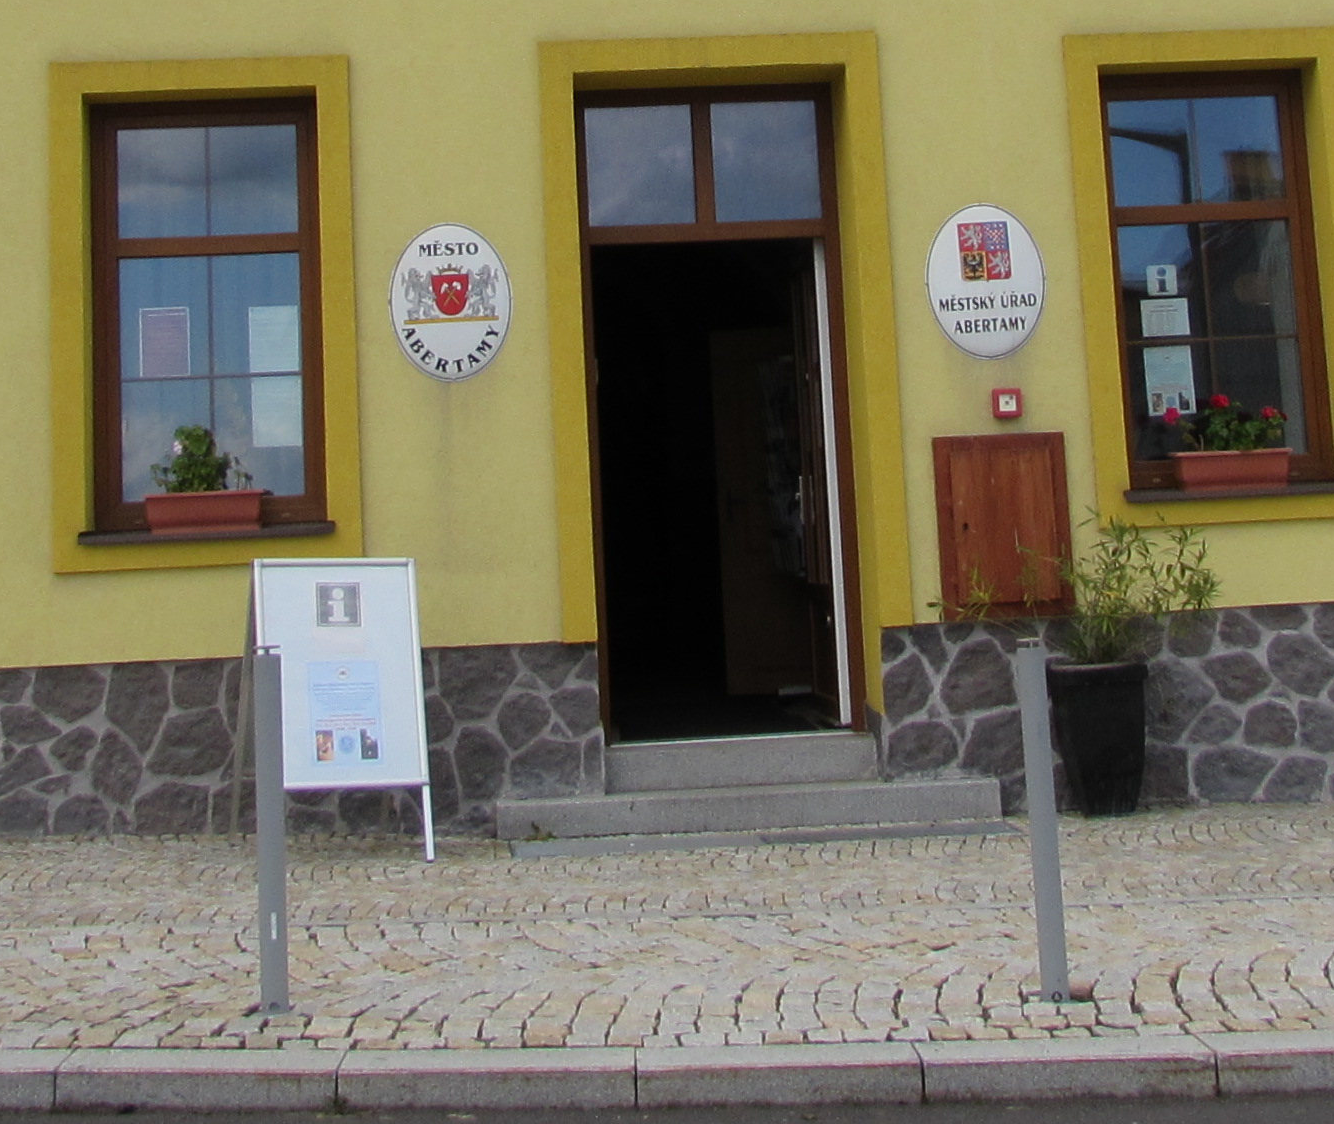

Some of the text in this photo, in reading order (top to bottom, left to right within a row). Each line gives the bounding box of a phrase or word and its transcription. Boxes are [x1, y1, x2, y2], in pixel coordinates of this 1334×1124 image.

[418, 239, 479, 257] MĚSTO
[938, 290, 1038, 313] MĚSTSKÝ ÚŘAD
[953, 315, 1028, 336] ABERTAMY
[401, 324, 500, 374] ABERTAMY
